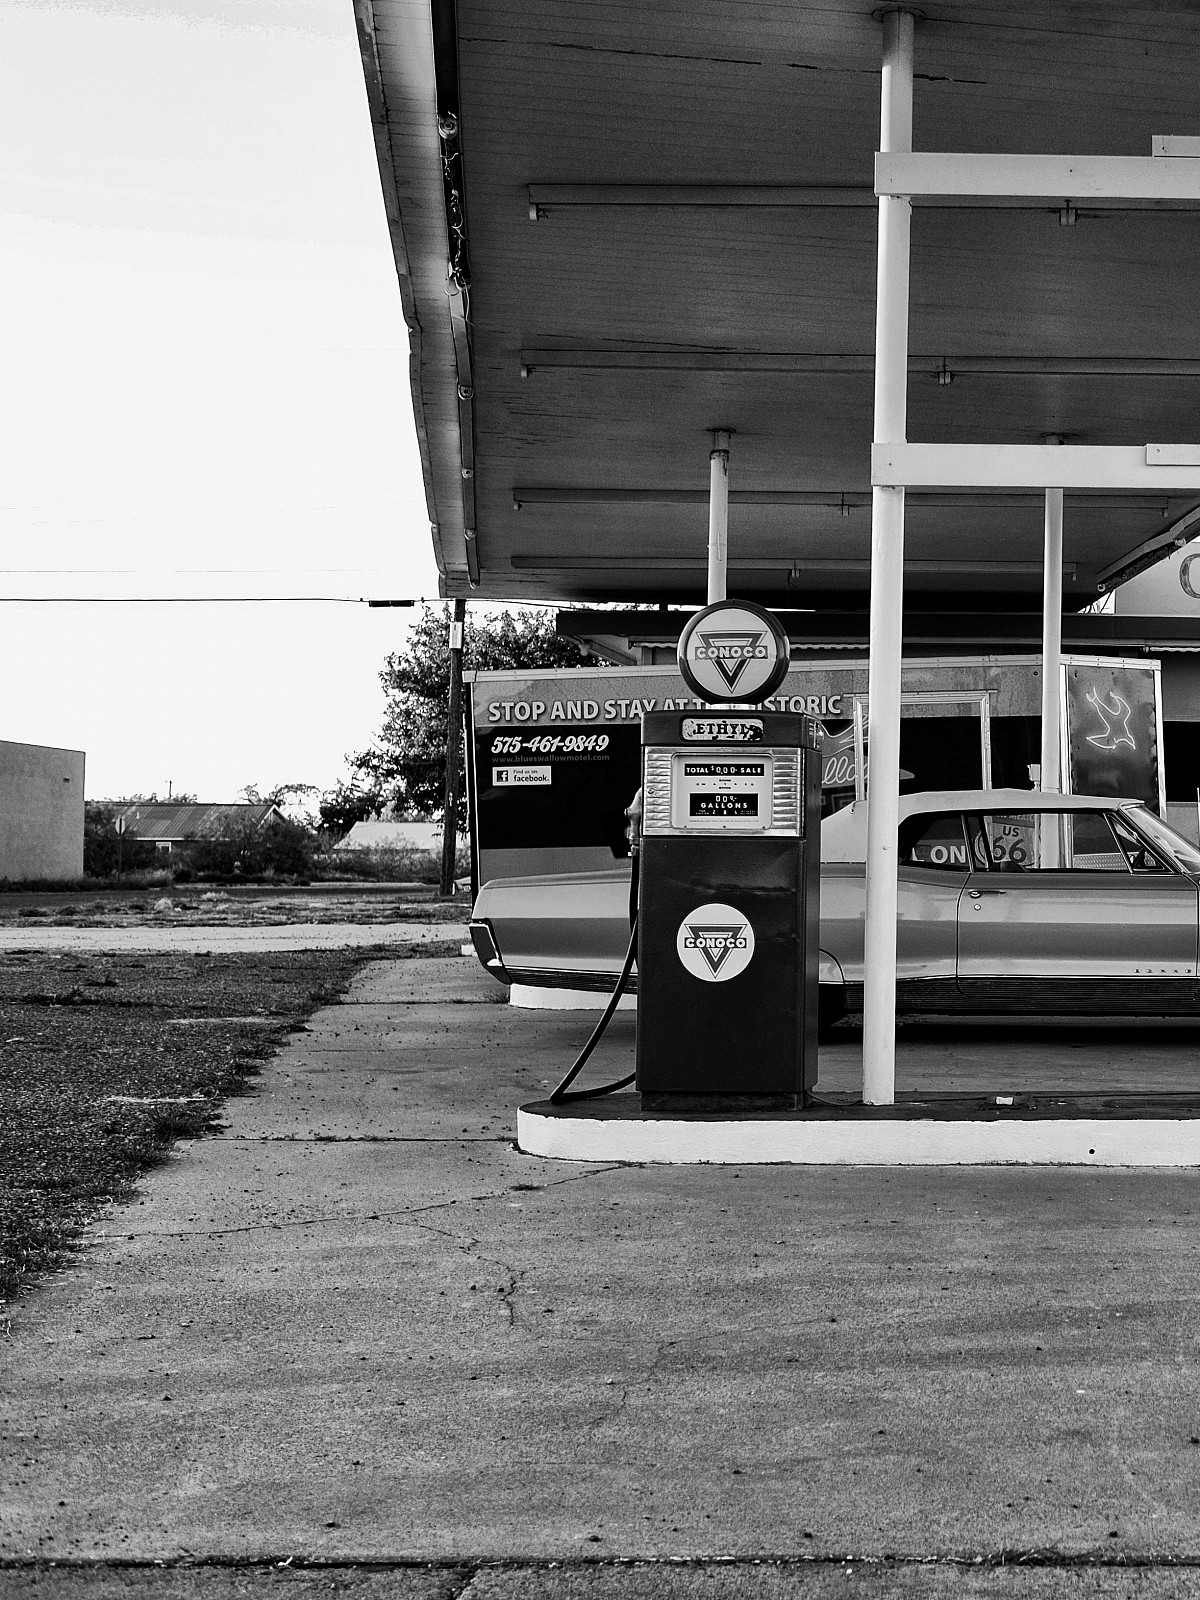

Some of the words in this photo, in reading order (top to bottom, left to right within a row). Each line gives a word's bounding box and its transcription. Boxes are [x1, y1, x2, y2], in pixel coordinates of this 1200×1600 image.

[696, 646, 766, 658] CONOCO
[488, 701, 546, 721] STOP
[550, 700, 599, 720] AND
[604, 699, 656, 719] STAY
[663, 698, 688, 710] AT
[757, 695, 841, 714] STORIC
[695, 723, 749, 735] ETHYL
[491, 735, 609, 754] 575-461-9849
[491, 753, 610, 763] www.blueswallowmotel.com
[513, 774, 547, 782] facebook
[1002, 825, 1020, 837] US
[930, 845, 966, 864] ON
[992, 836, 1027, 863] 66
[685, 937, 747, 948] CONOCO
